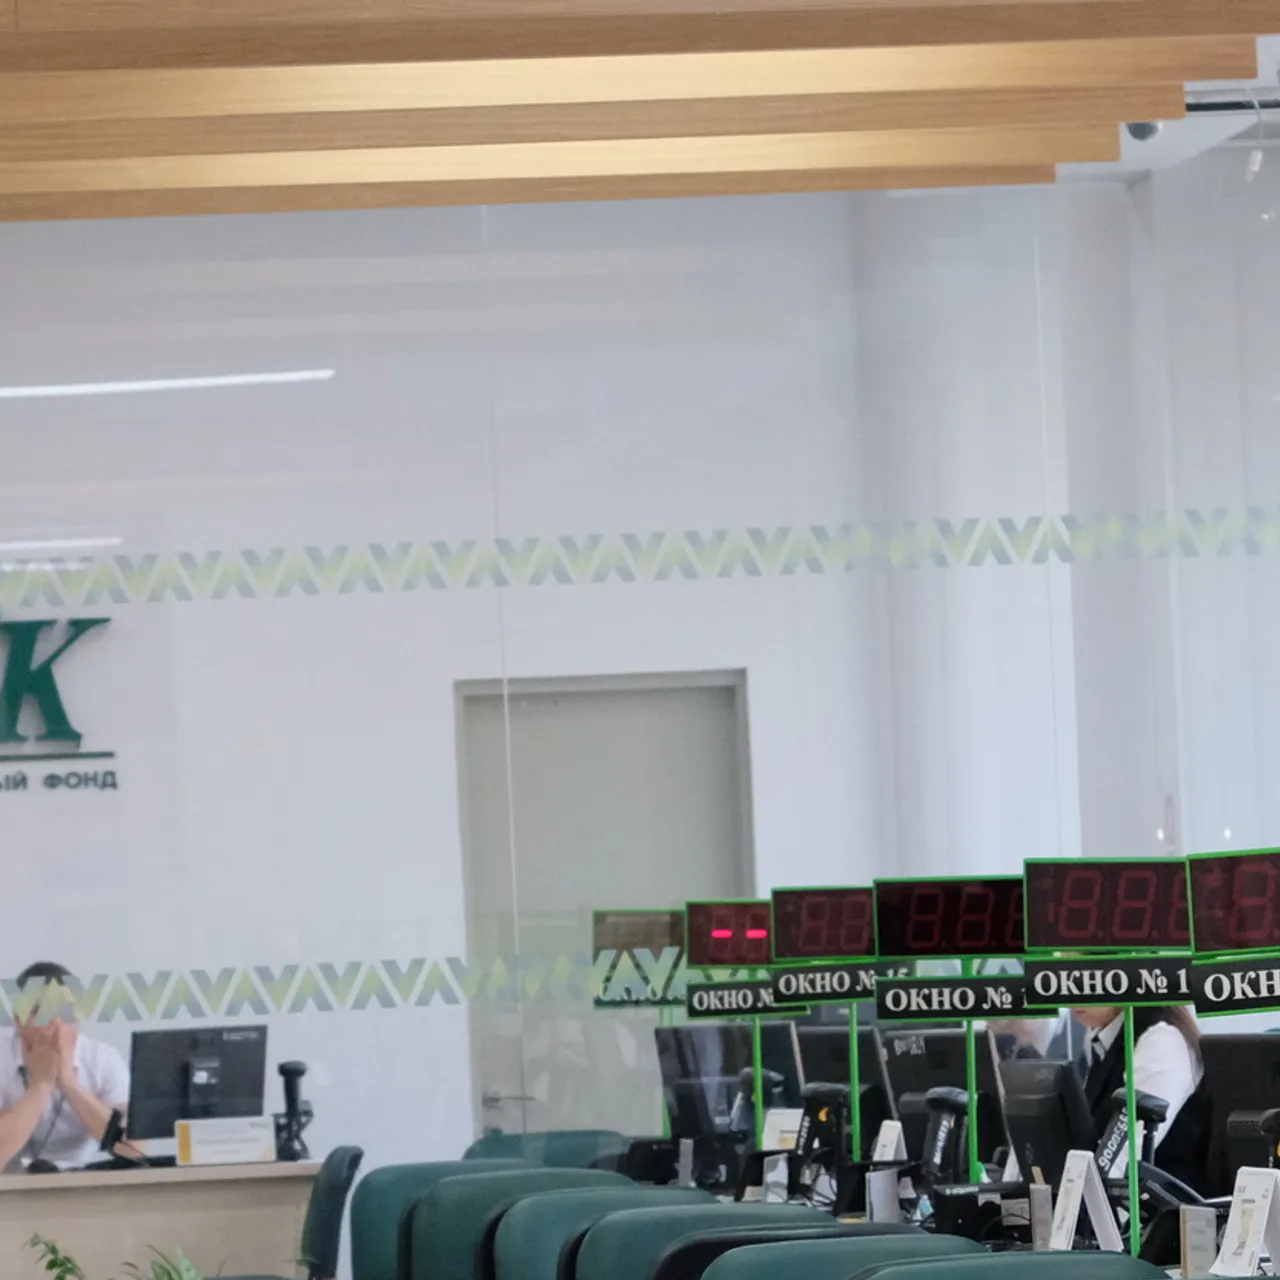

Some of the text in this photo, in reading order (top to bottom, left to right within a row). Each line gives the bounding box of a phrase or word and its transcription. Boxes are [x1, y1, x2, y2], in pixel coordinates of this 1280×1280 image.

[43, 770, 119, 790] ФОНД
[778, 970, 851, 995] ОКНО
[1033, 969, 1129, 996] ОКНО
[1136, 968, 1169, 994] №
[691, 988, 754, 1012] ОКНО
[884, 986, 976, 1012] ОКНО
[982, 986, 1013, 1010] №
